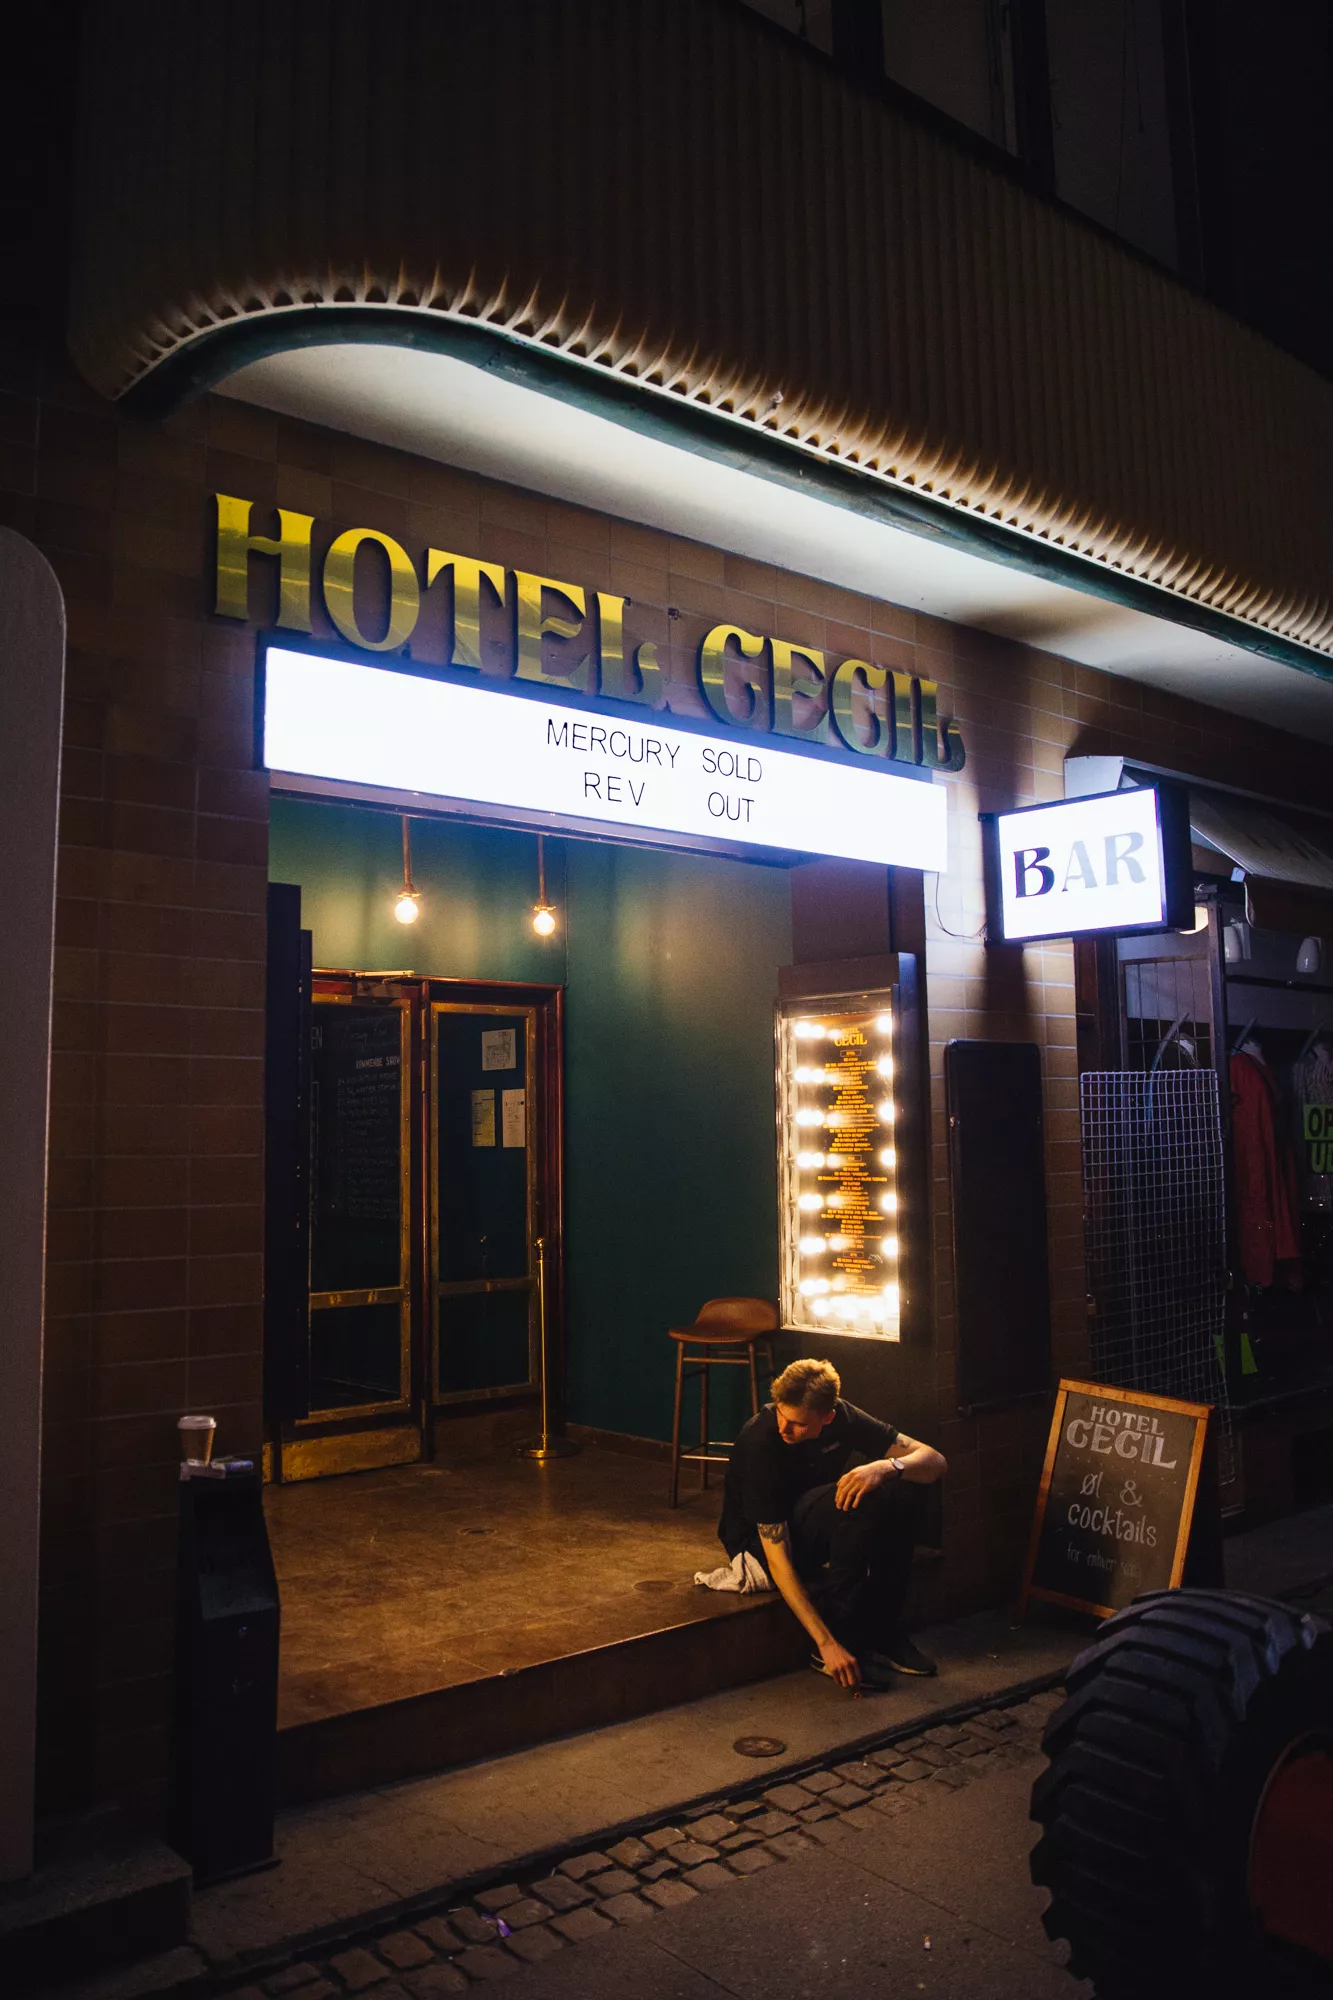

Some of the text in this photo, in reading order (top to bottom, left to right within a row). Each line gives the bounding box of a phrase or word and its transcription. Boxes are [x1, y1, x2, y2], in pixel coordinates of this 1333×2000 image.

[211, 492, 966, 772] HOTEL CECIL
[546, 718, 763, 783] MERCURY SOLD
[583, 771, 755, 823] REV OUT
[1013, 831, 1147, 898] BAR
[1066, 1418, 1177, 1470] CECIL
[1091, 1405, 1165, 1436] HOTEL
[1119, 1479, 1143, 1508] &
[1068, 1503, 1157, 1547] cocktails
